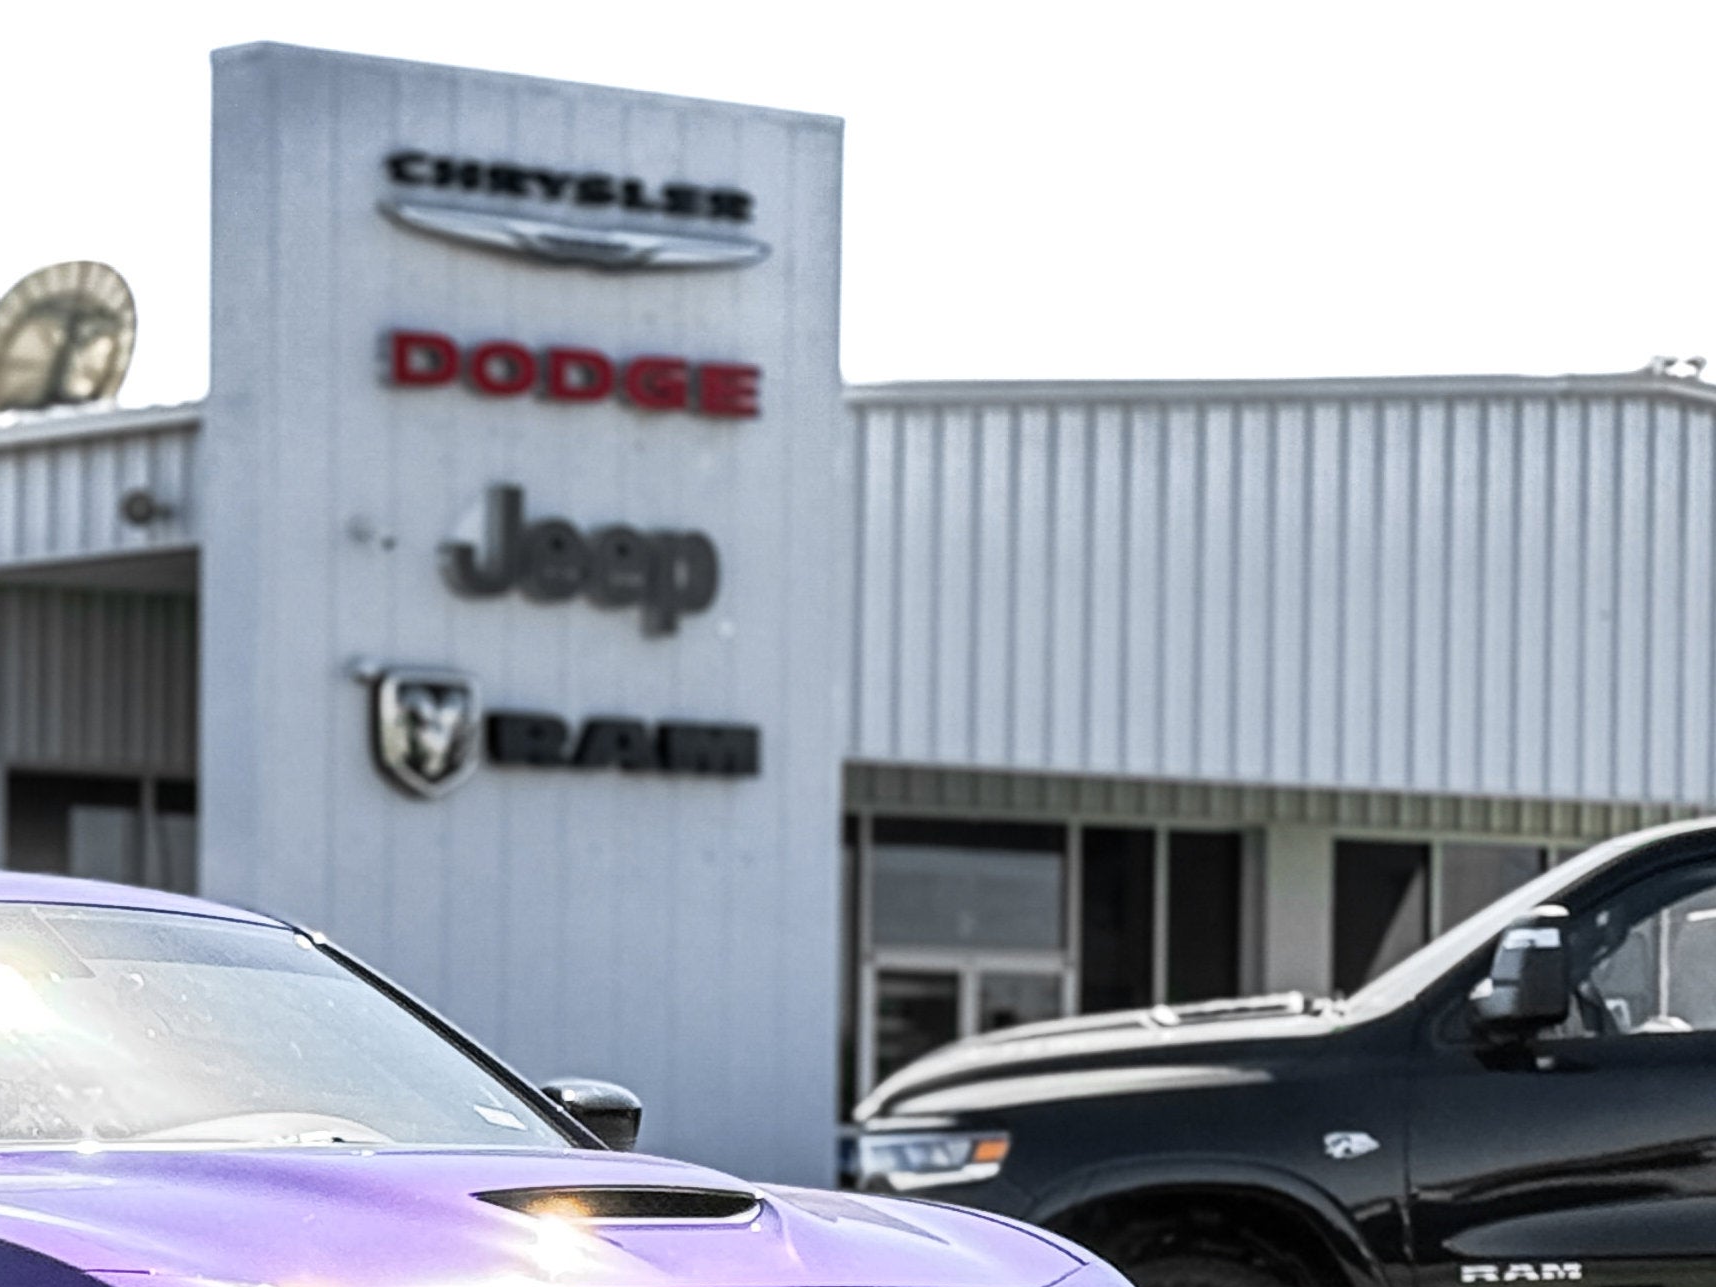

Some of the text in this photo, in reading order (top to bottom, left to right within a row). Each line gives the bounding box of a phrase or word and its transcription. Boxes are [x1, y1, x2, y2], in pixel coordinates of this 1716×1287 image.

[385, 150, 755, 222] CHRYSLER
[383, 328, 762, 418] DODGE
[439, 484, 719, 637] Jeep
[485, 710, 759, 776] RAM
[1461, 1262, 1583, 1283] RAM
